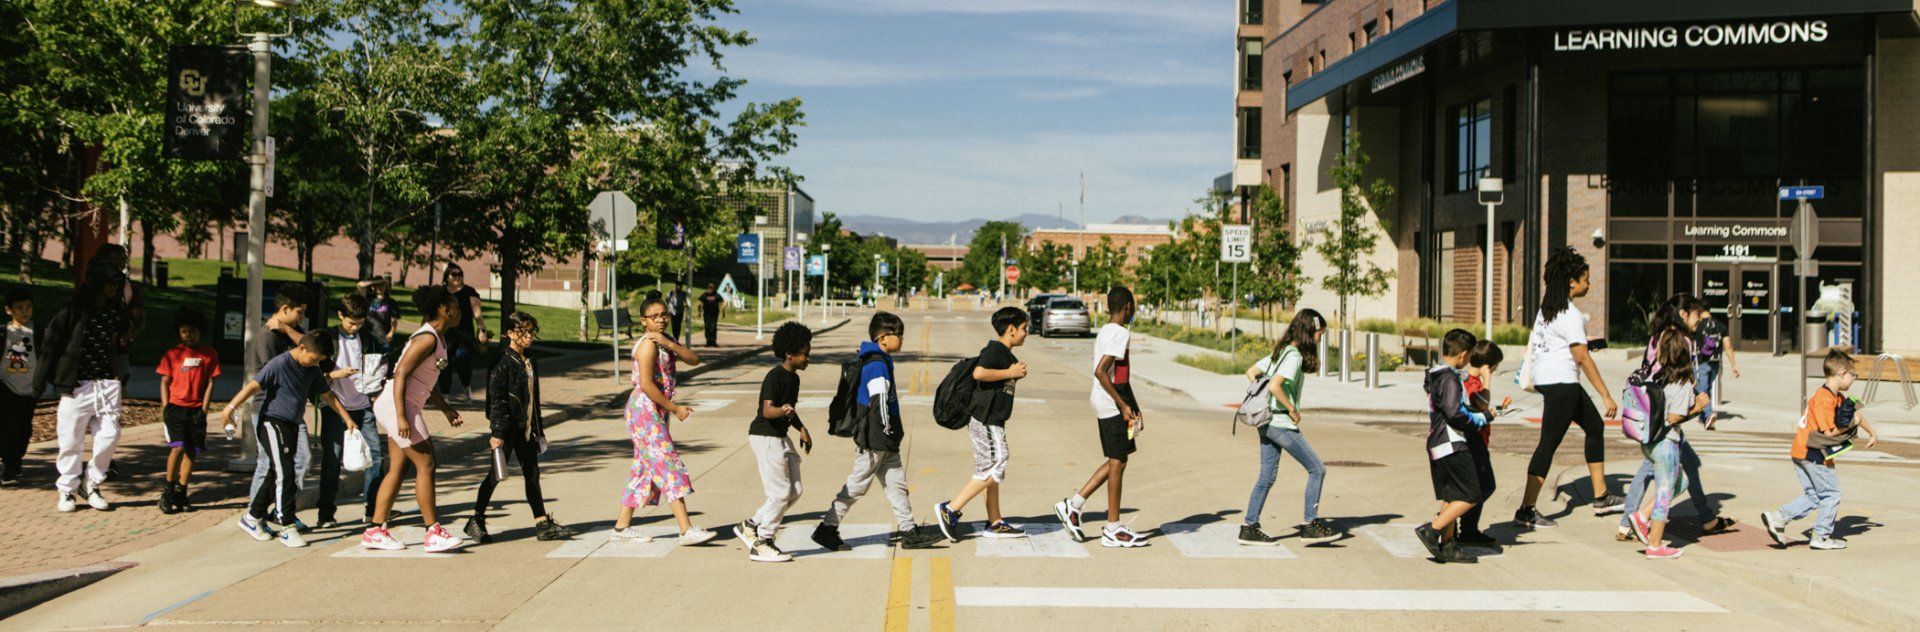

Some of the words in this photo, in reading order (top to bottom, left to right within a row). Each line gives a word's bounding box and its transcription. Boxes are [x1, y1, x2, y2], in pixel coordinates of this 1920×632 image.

[1554, 27, 1678, 51] LEARNING
[1684, 20, 1829, 48] COMMONS
[176, 102, 225, 115] University
[175, 114, 187, 124] of
[188, 113, 235, 125] Colorado
[174, 125, 211, 136] Denver
[1685, 224, 1730, 238] Learning
[1732, 224, 1787, 236] Commons
[1228, 244, 1245, 258] 15
[1723, 244, 1749, 256] 1191
